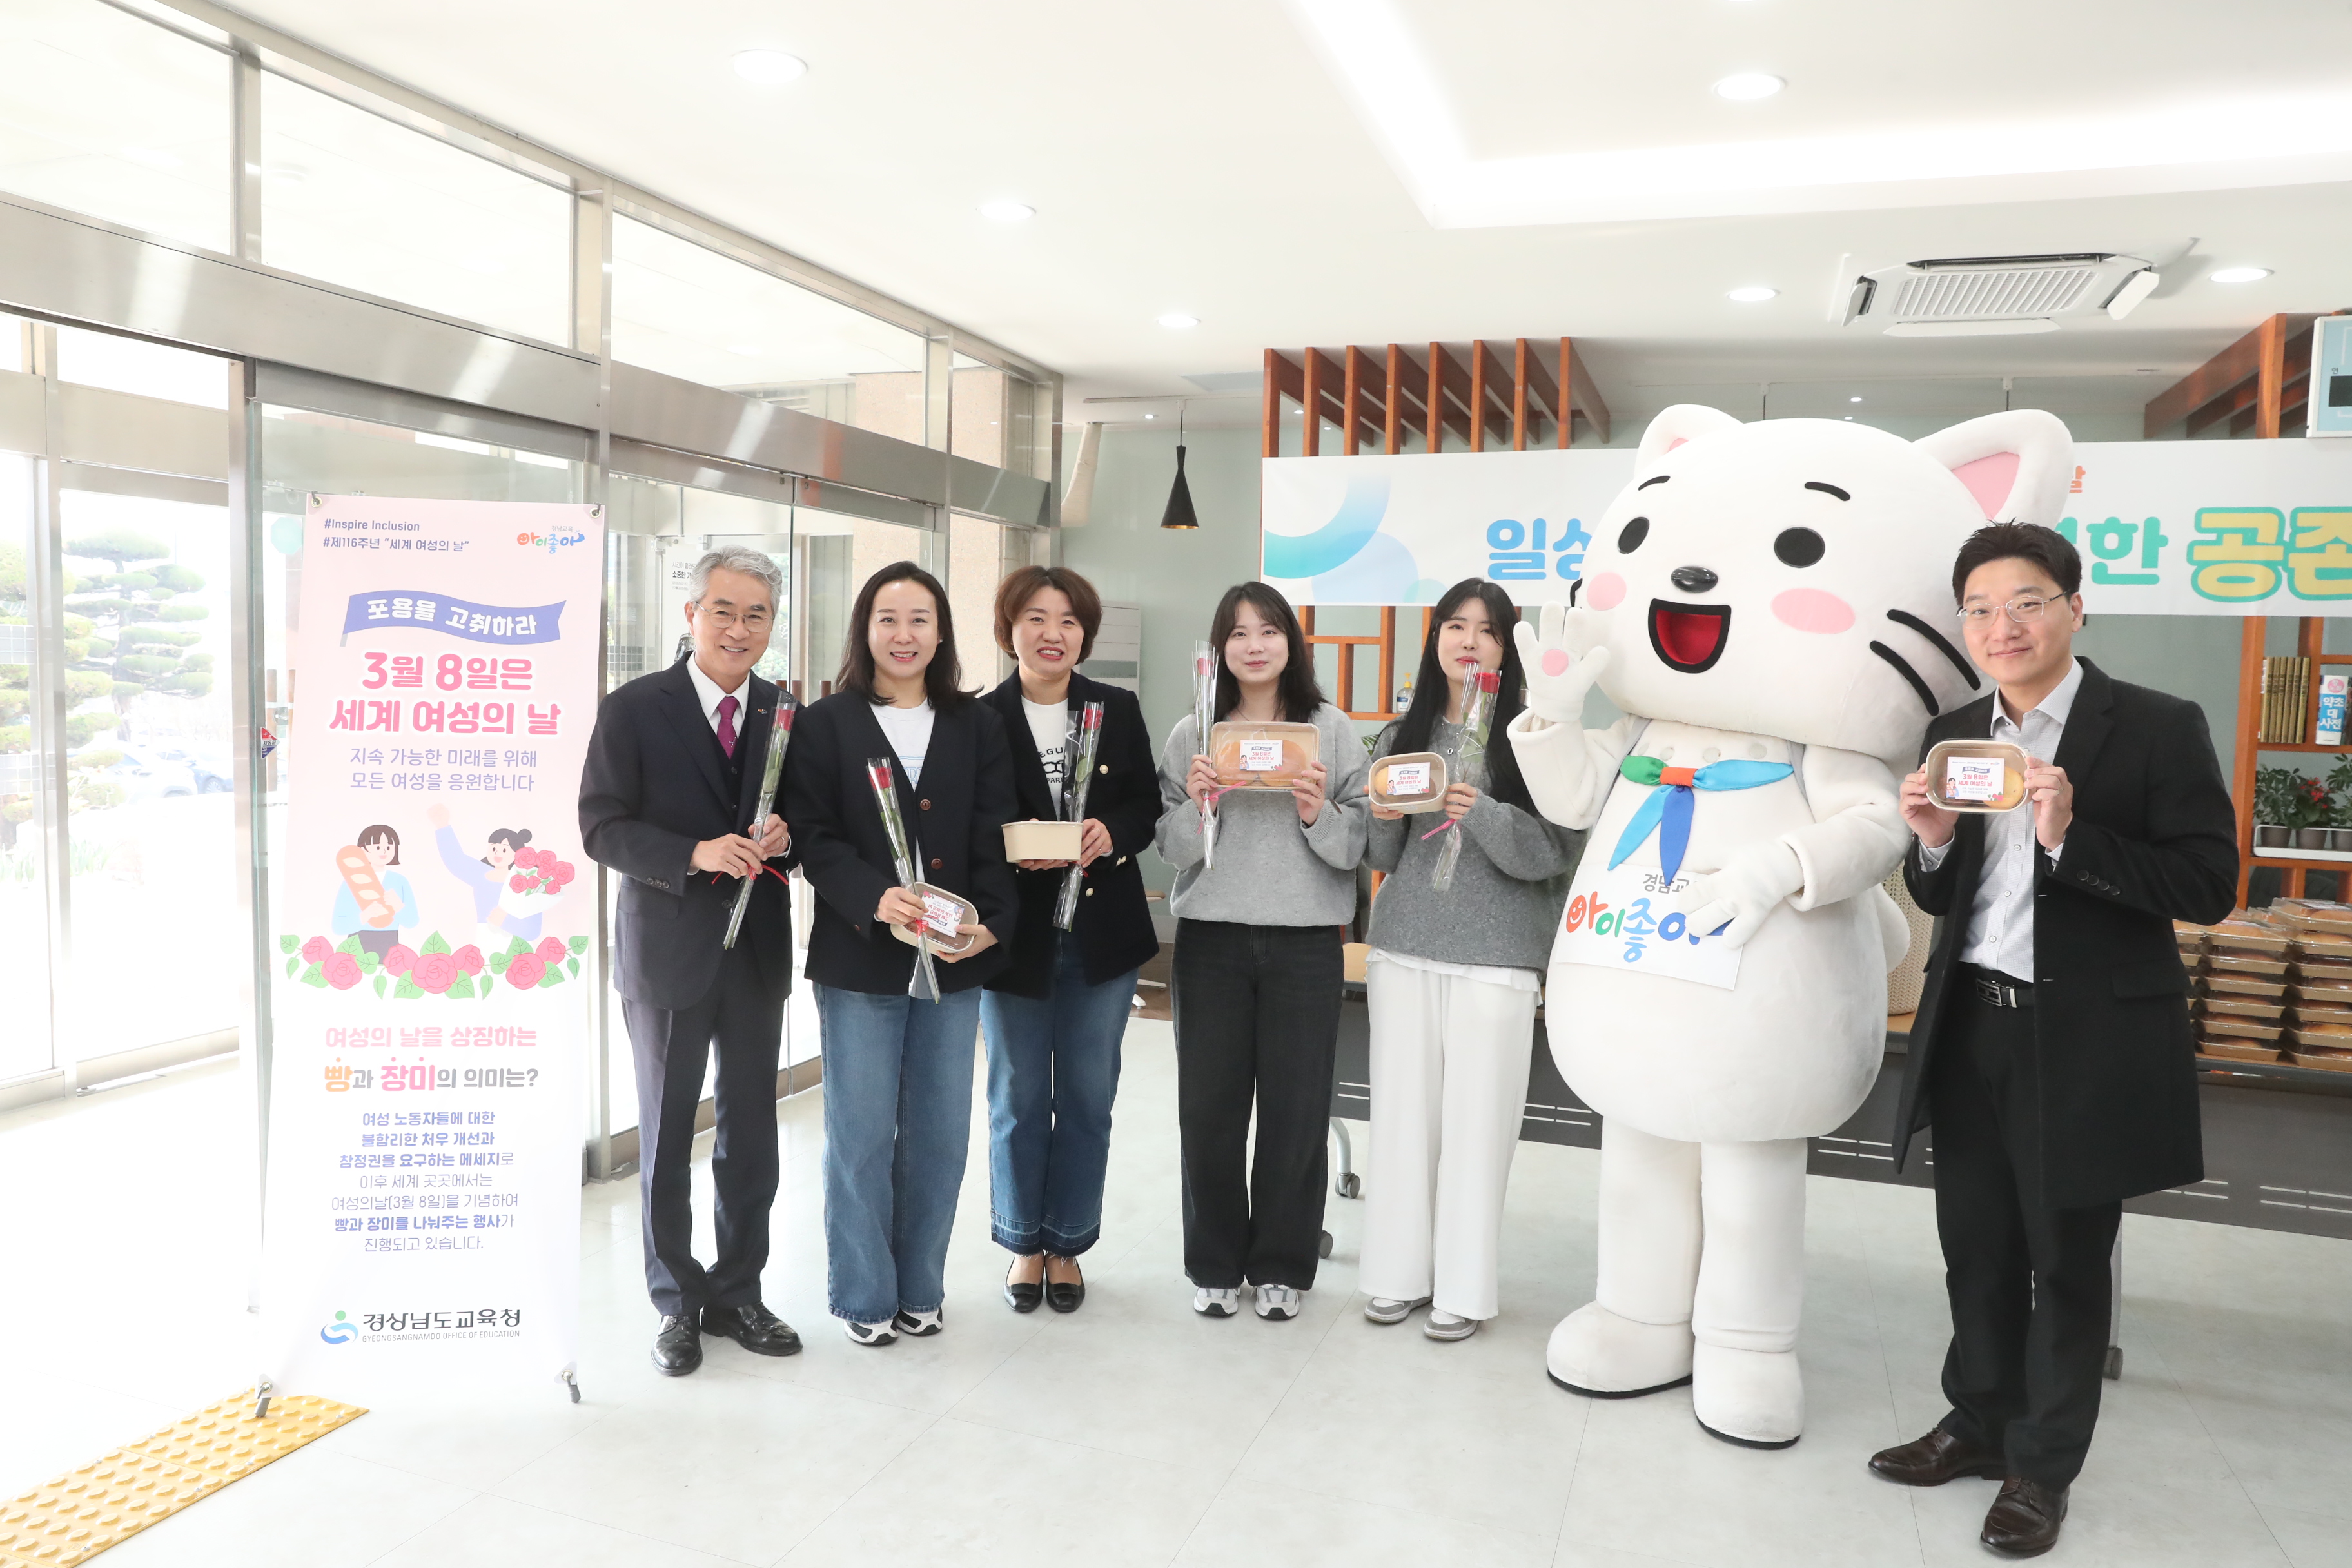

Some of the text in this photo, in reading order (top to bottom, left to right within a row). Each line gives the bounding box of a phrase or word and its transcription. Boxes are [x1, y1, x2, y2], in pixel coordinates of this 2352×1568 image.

[324, 519, 419, 531] #Inspire Inclusion
[323, 537, 379, 549] #제116주년
[416, 540, 449, 551] 여성의
[517, 531, 585, 554] 아이좋아
[672, 571, 686, 579] 소중한
[368, 598, 536, 636] 포용을 고취하라
[362, 652, 533, 691] 3월 8일은
[2323, 696, 2344, 708] 약초
[329, 700, 561, 735] 세계 여성의 날
[2327, 709, 2339, 718] 대
[2320, 718, 2342, 730] 사전
[350, 748, 536, 767] 지속 가능한 미래를 위해
[351, 773, 534, 791] 모든 여성을 응원합니다
[326, 1026, 536, 1048] 여성의 날을 상징하는
[324, 1065, 538, 1092] 빵과 장미의 의미는?
[363, 1111, 495, 1126] 여성 노동자들에 대한
[362, 1132, 495, 1147] 불합리한 처우 개선과
[340, 1153, 513, 1168] 참정권을 요구하는 메세지로
[360, 1173, 492, 1188] 이후 세계 곳곳에서는
[419, 1195, 459, 1208] 8일)을
[464, 1193, 518, 1207] 기념하여
[335, 1215, 513, 1231] 빵과 장미를 나눠주는 행사가
[365, 1236, 483, 1251] 진행되고 있습니다.
[364, 1309, 520, 1331] 경상남도교육청
[362, 1333, 440, 1342] GYEONGSANGNAMDO
